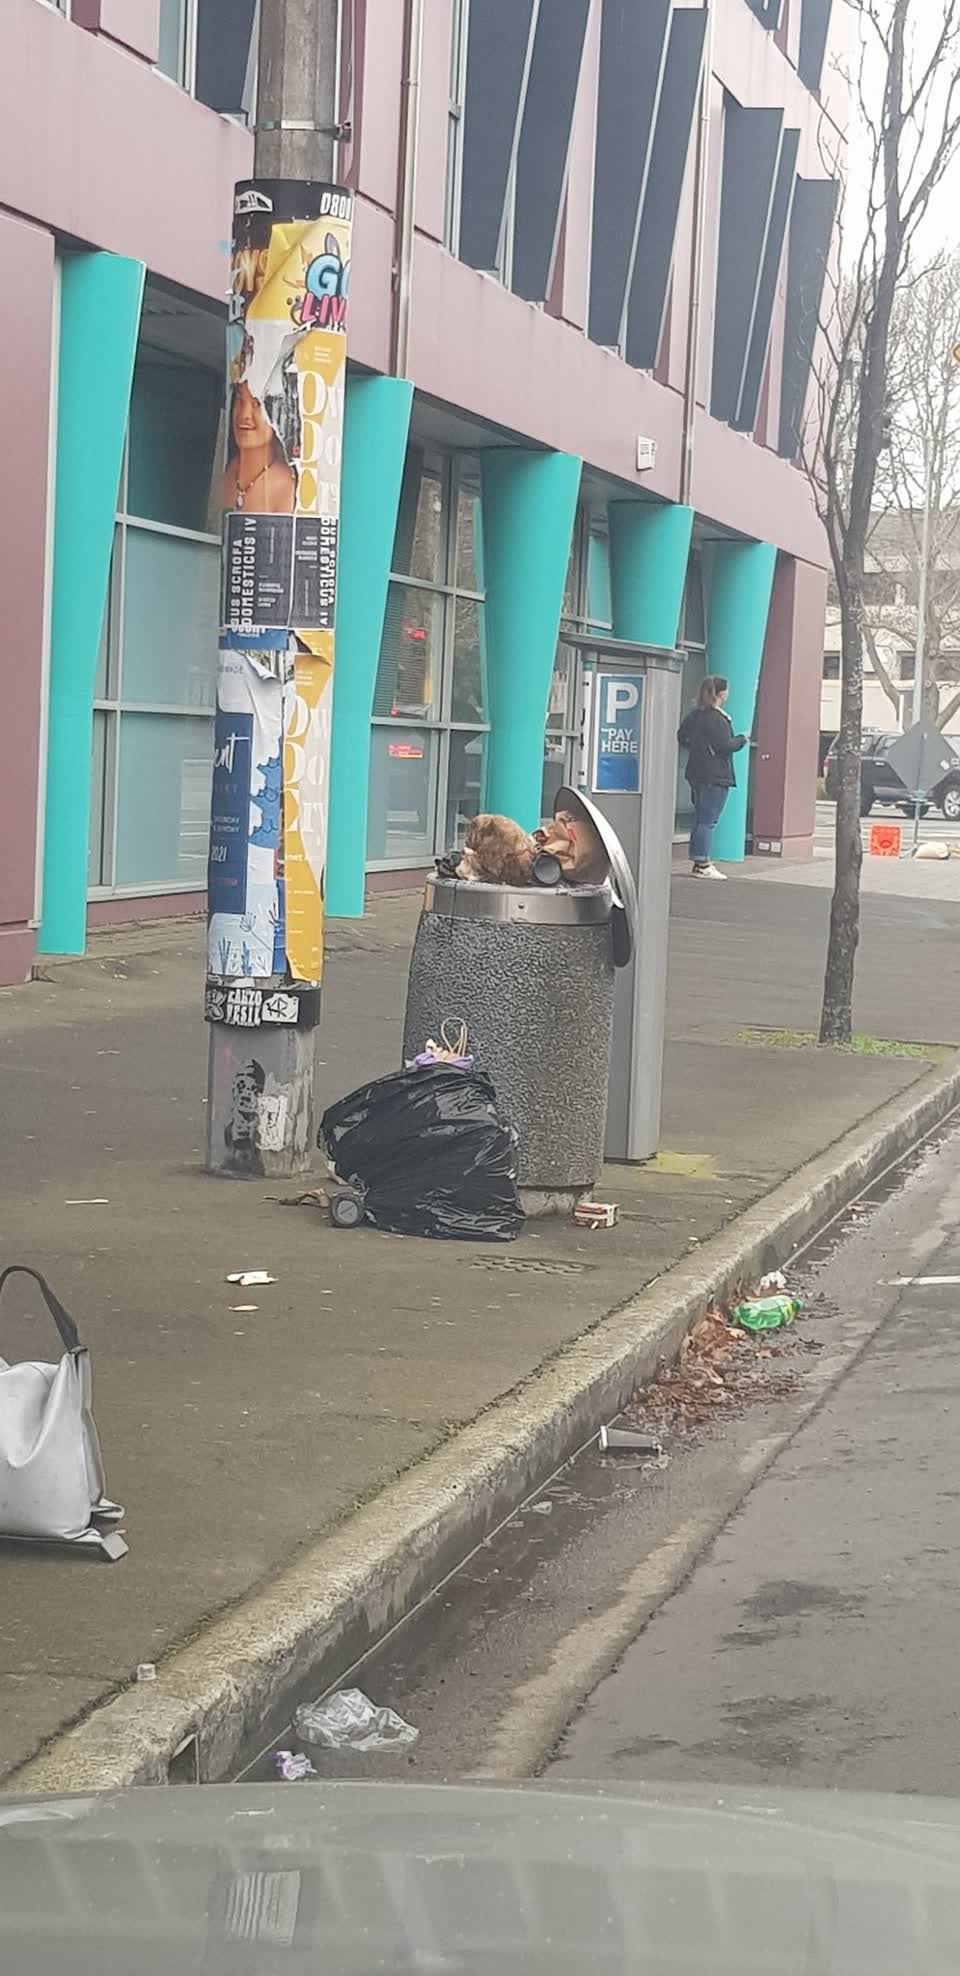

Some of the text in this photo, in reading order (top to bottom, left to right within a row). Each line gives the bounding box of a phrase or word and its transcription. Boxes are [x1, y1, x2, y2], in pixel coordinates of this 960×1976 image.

[245, 518, 256, 532] IV
[241, 537, 256, 626] DOMESTICUS
[606, 682, 639, 724] P
[608, 728, 633, 741] PAY
[601, 740, 638, 753] HERE
